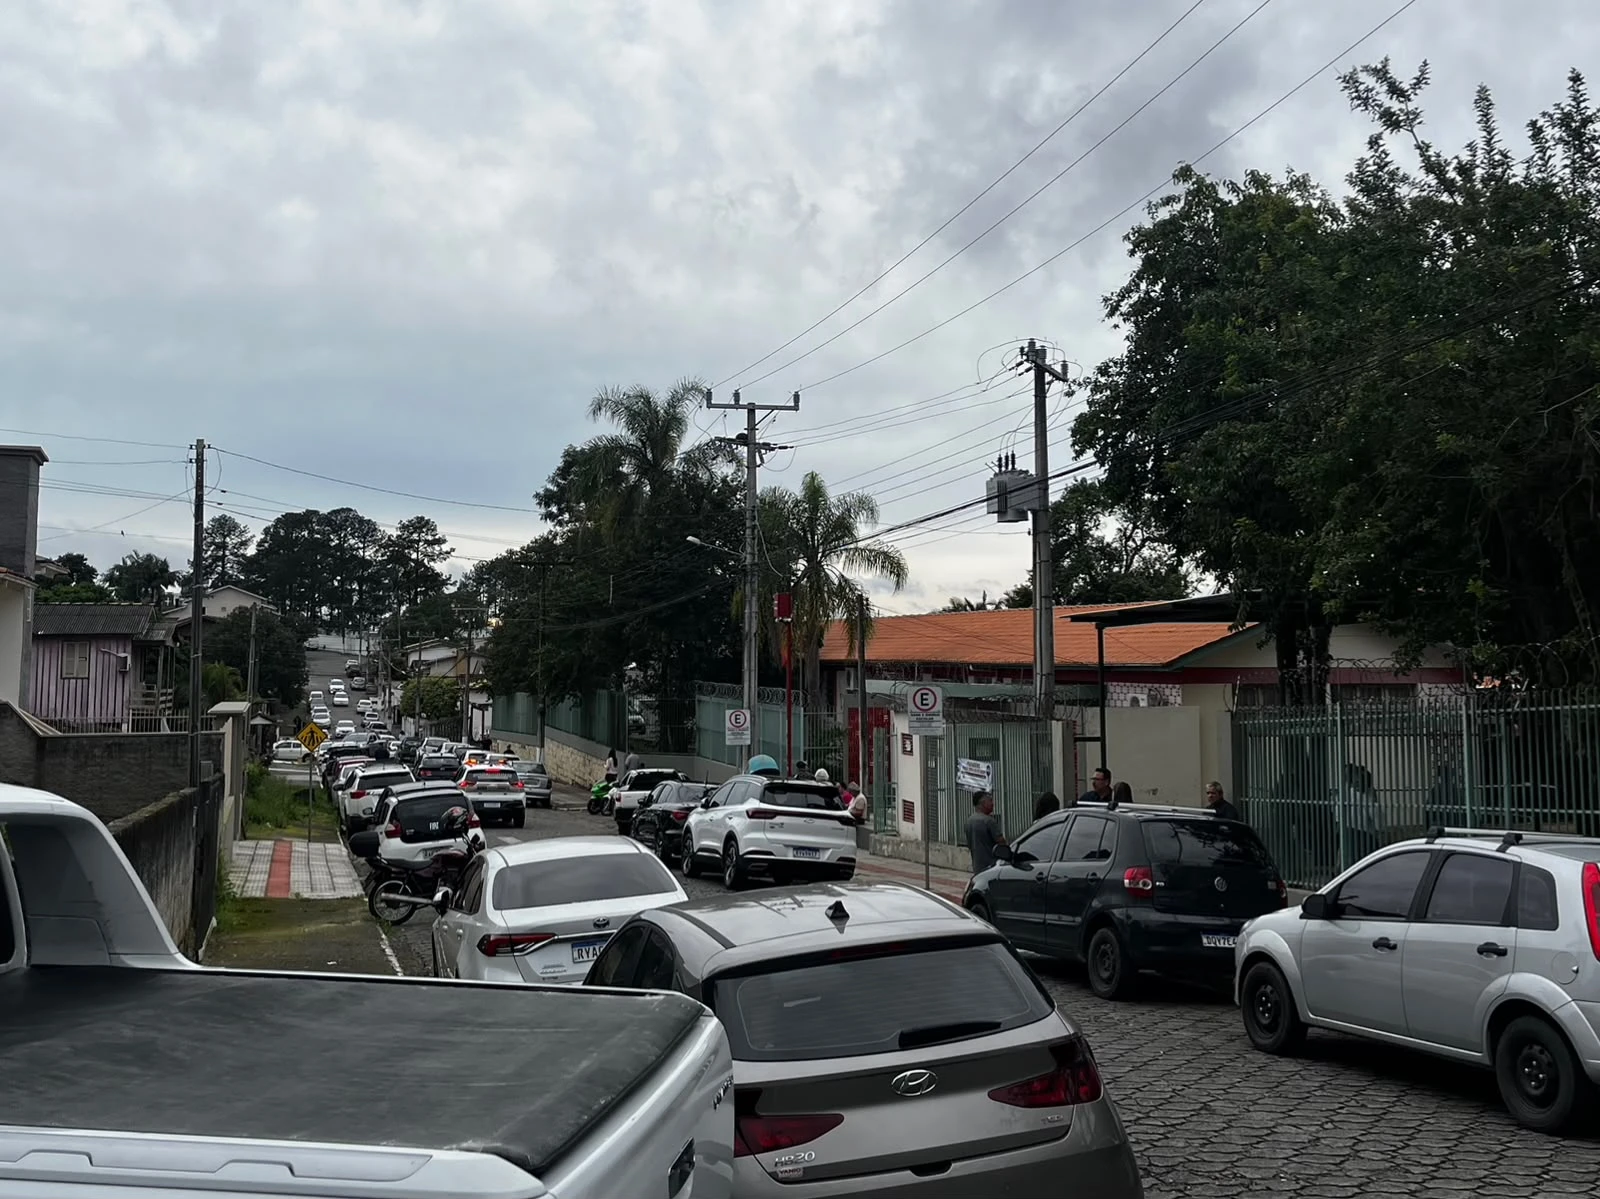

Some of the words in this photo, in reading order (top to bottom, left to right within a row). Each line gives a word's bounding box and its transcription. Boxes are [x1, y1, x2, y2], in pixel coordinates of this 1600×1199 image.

[920, 692, 930, 706] E
[734, 713, 741, 724] E
[774, 1150, 816, 1167] HB20
